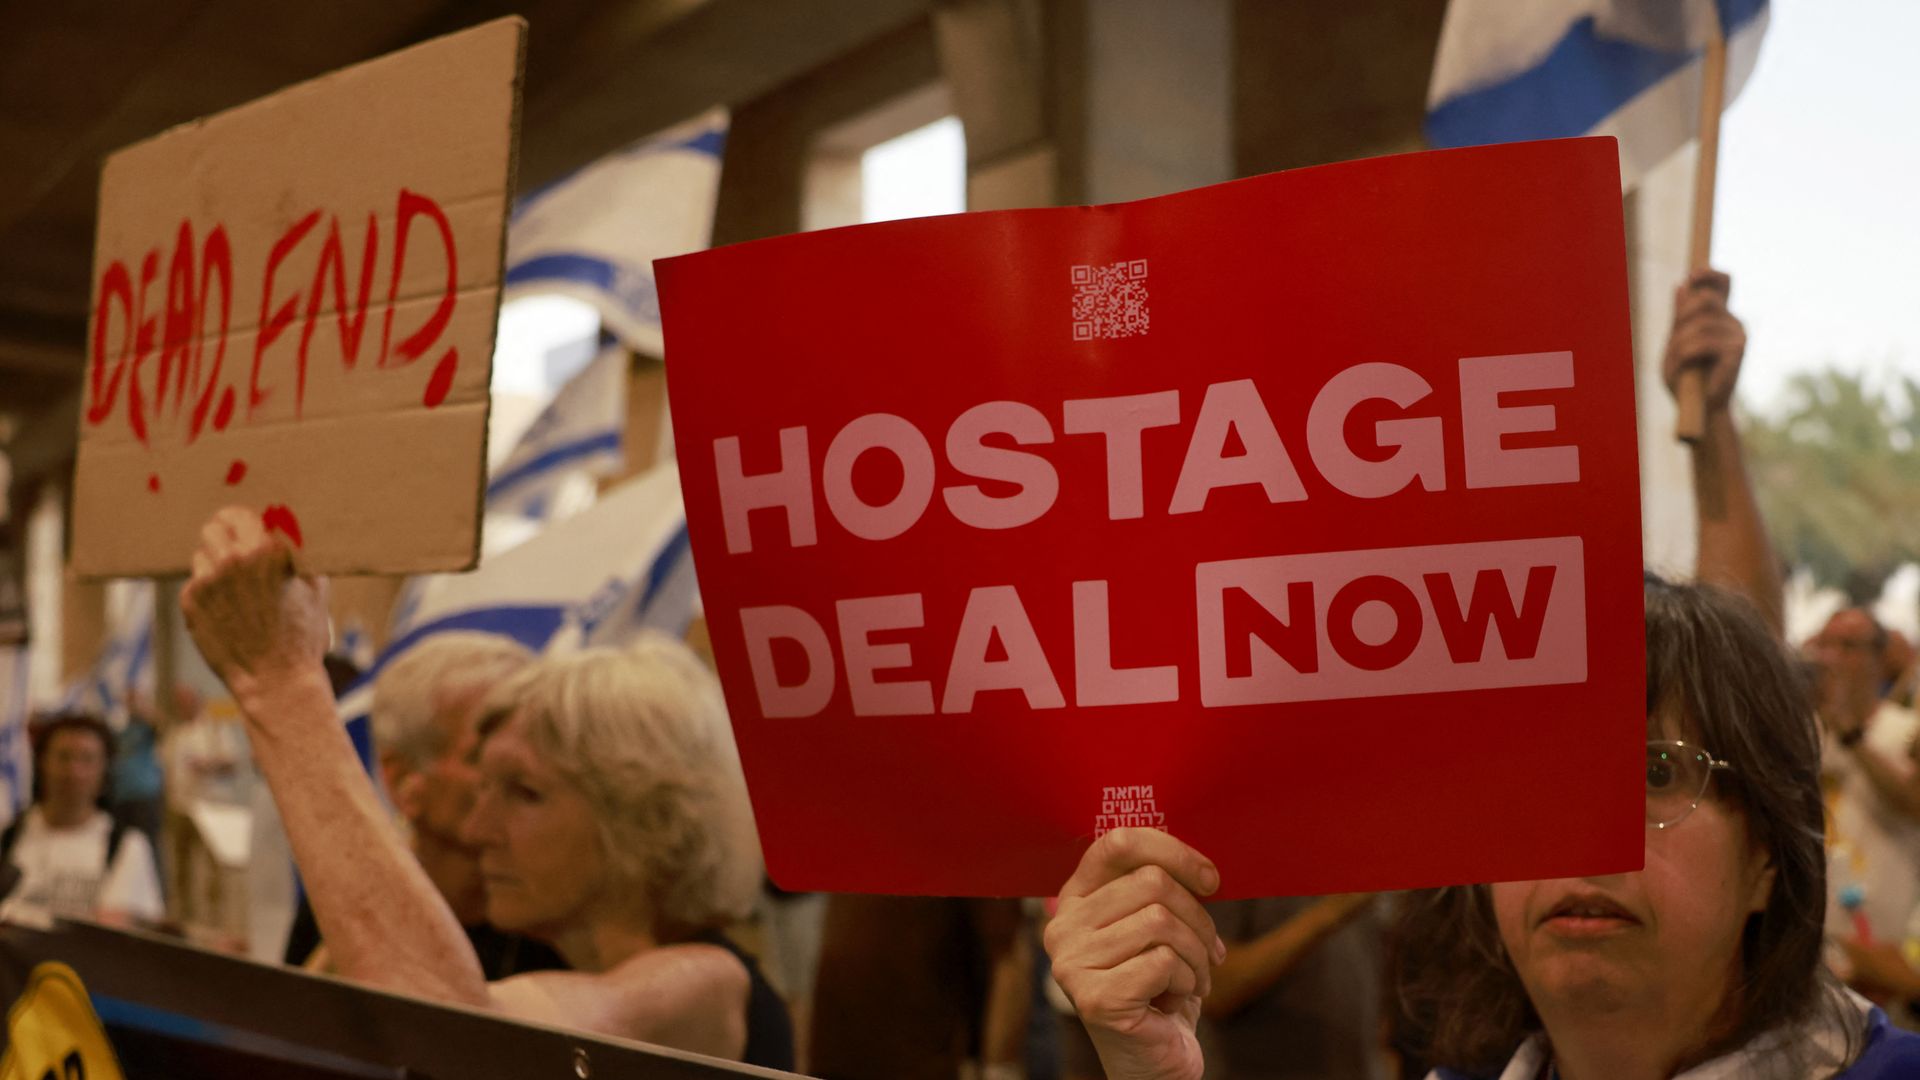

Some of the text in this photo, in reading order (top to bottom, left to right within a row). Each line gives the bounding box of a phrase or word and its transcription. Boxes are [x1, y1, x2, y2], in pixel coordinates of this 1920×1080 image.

[714, 351, 1580, 554] HOSTAGE
[740, 566, 1557, 718] DEAL NOW
[1103, 785, 1154, 800] מחאת
[1102, 799, 1156, 813] הנשים
[1095, 812, 1165, 827] להחזרת
